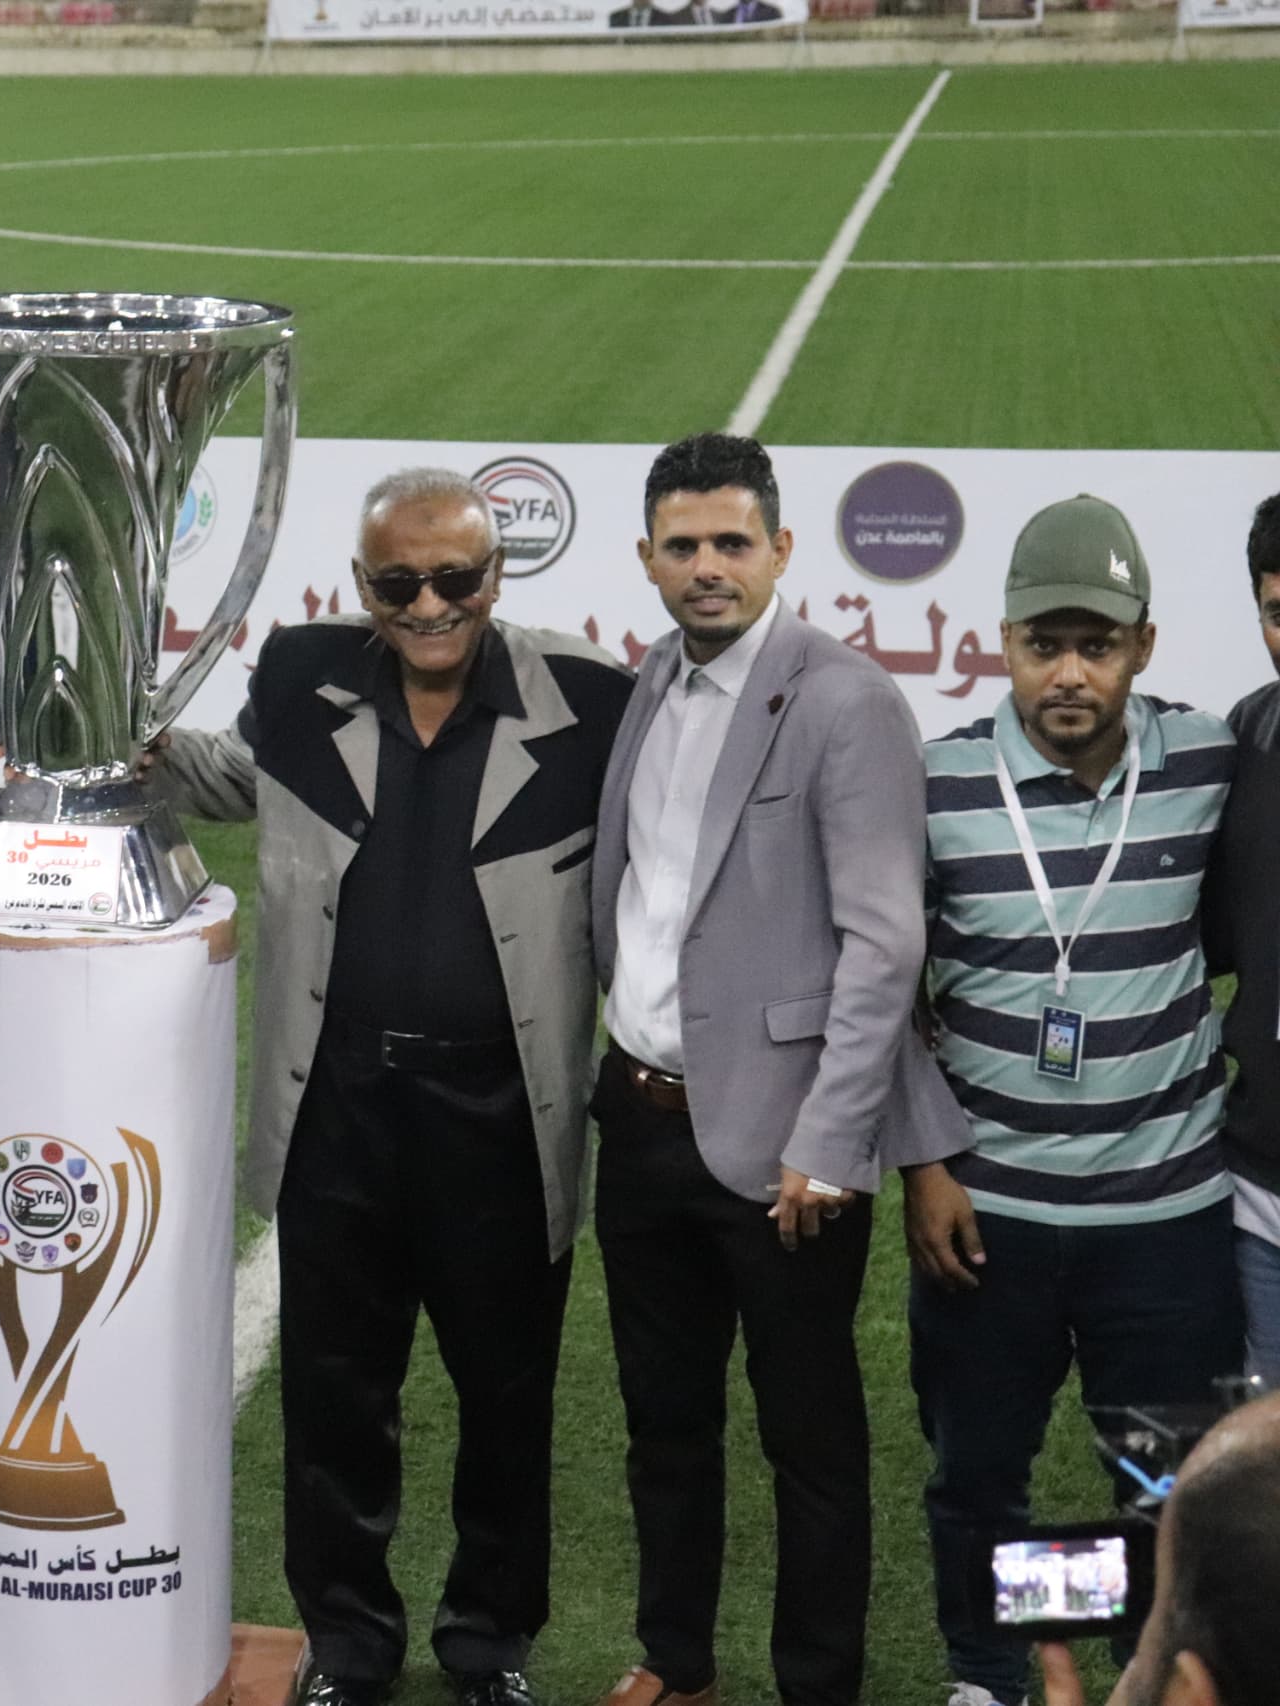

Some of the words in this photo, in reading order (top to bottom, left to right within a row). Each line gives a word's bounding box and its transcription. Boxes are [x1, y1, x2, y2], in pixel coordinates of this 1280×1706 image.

[511, 498, 558, 521] YFA
[23, 830, 88, 852] بطل
[7, 850, 29, 863] 30
[26, 872, 72, 887] 2026
[34, 1190, 65, 1205] YFA
[47, 1544, 97, 1576] كأس
[105, 1544, 180, 1575] بطل
[0, 1575, 113, 1601] AL-MURAISI
[117, 1577, 157, 1600] CUP
[161, 1570, 182, 1594] 30
